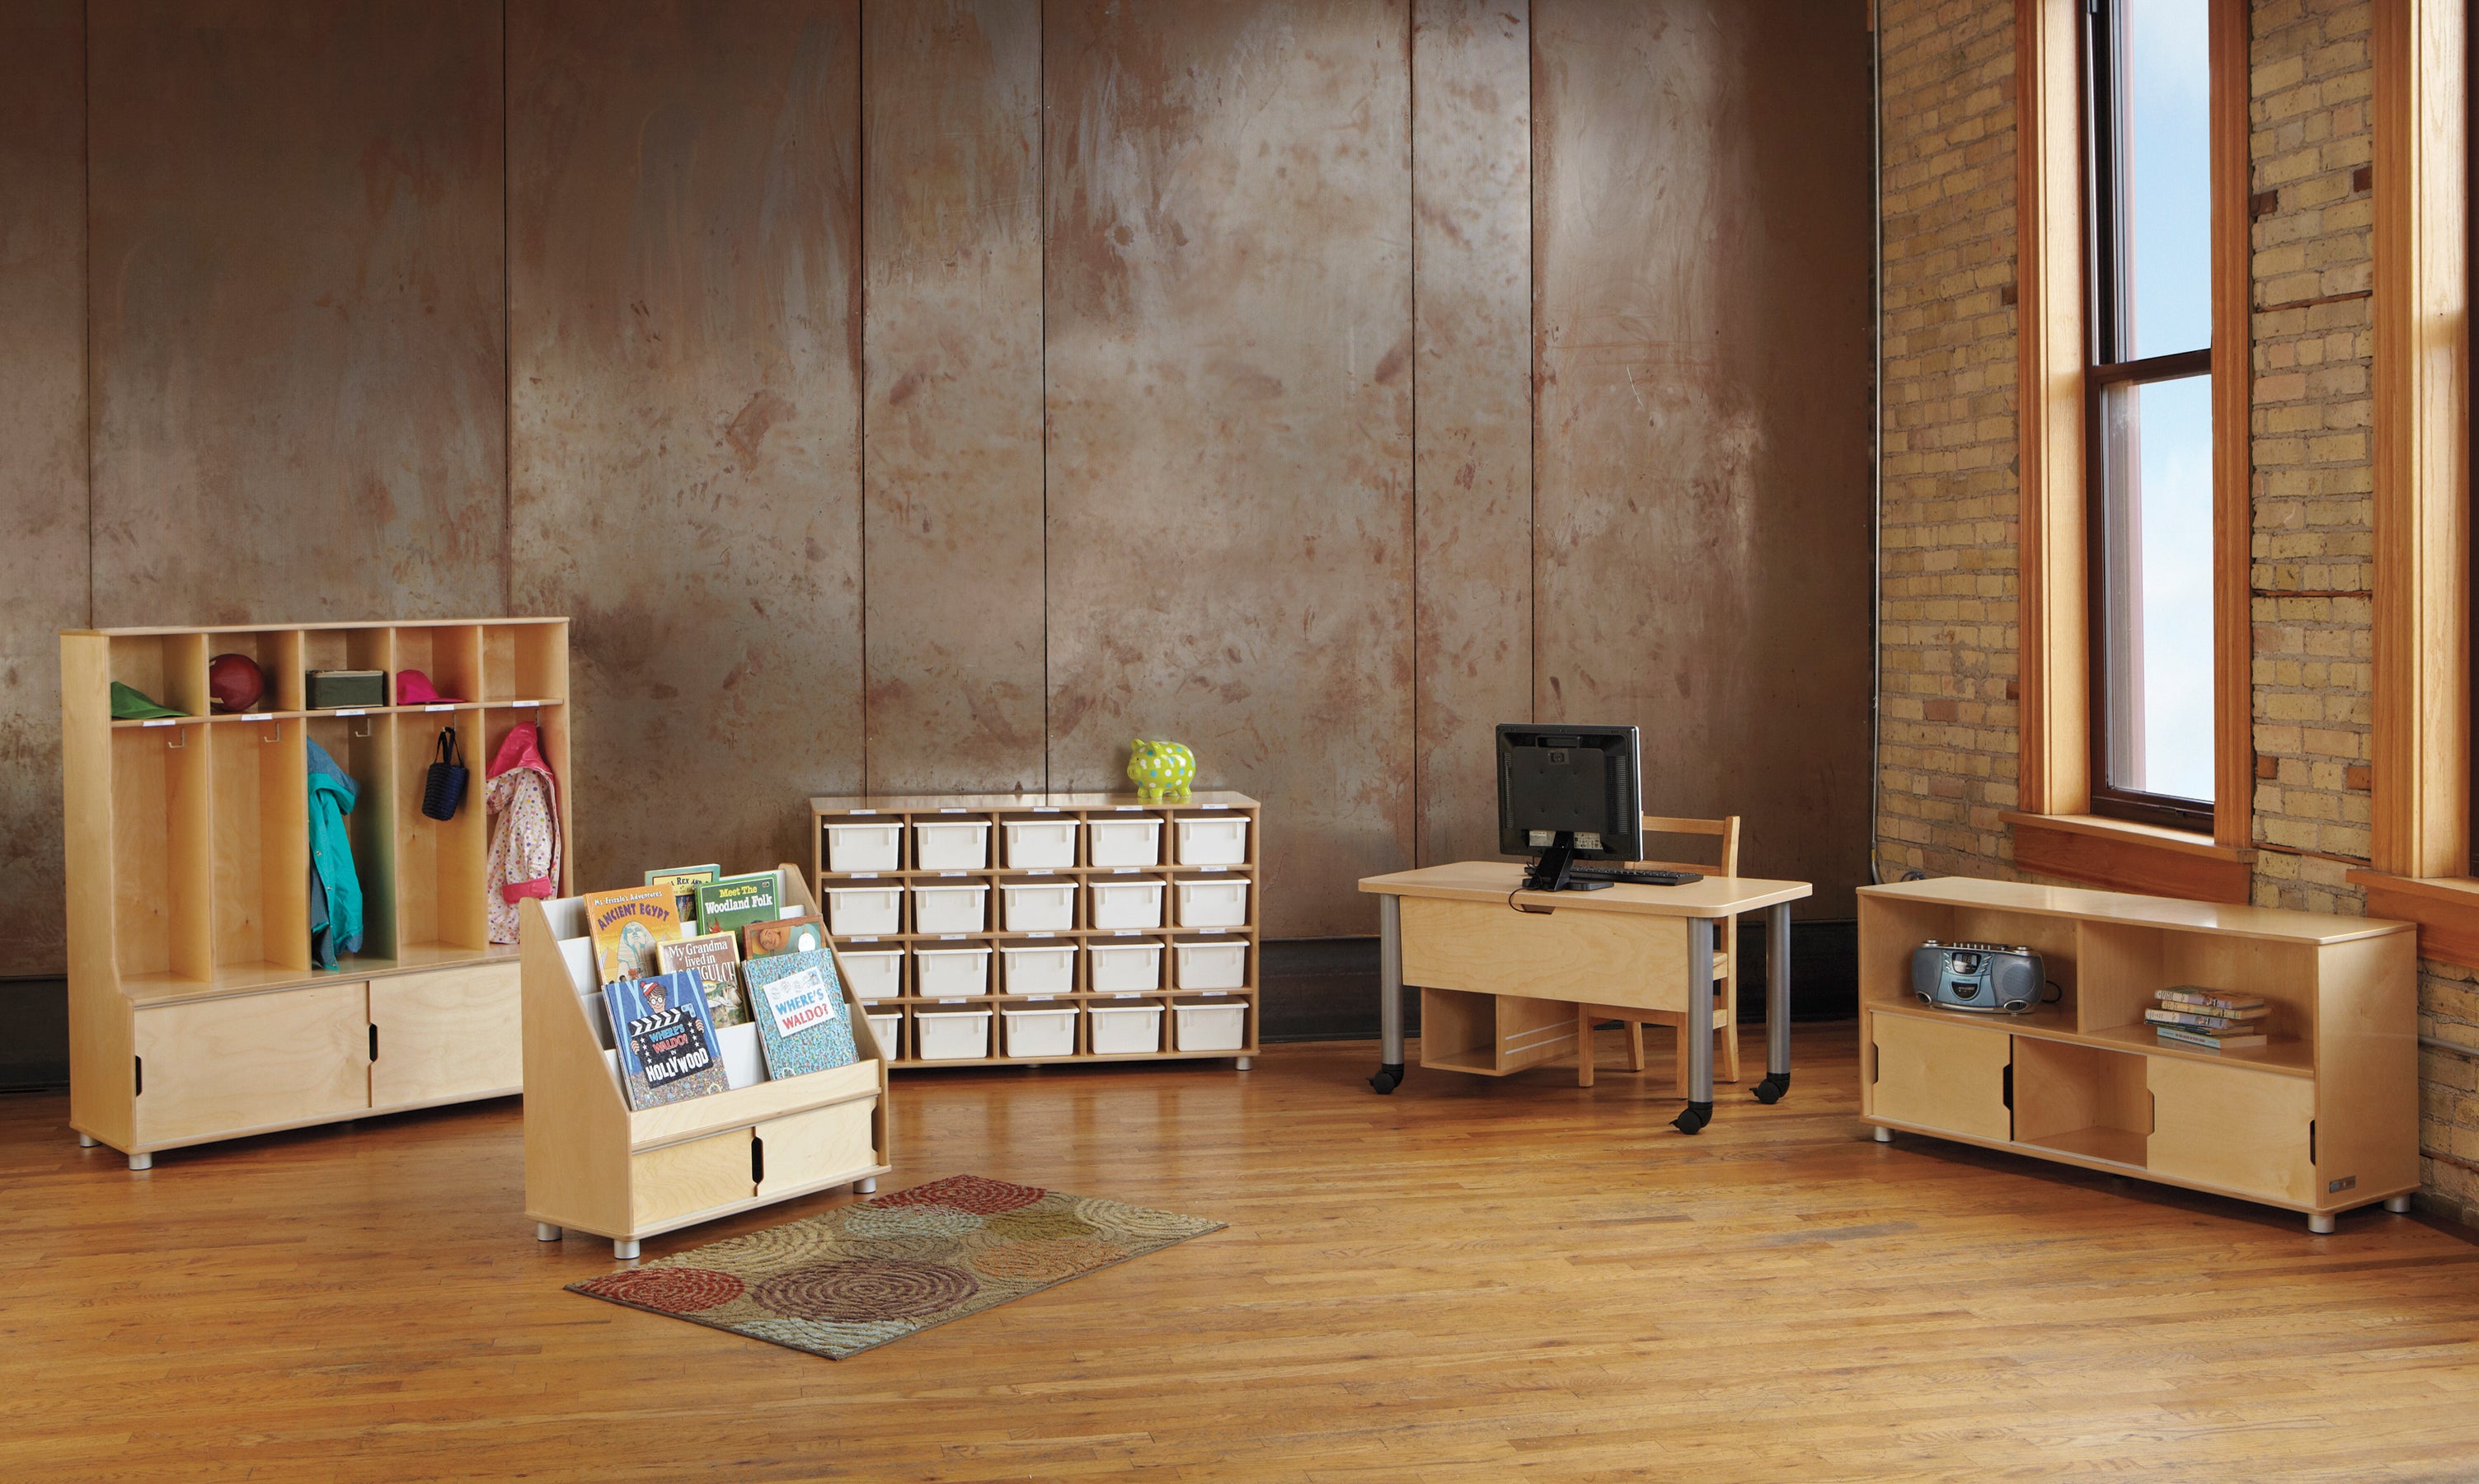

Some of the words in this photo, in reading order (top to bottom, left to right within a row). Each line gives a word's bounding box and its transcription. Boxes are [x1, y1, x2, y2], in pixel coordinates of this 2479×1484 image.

[630, 891, 663, 901] Adventures
[719, 886, 740, 898] Meet
[741, 885, 758, 894] The
[705, 897, 750, 914] Woodland
[751, 894, 772, 907] Folk
[597, 903, 636, 931] ANCIENT
[640, 903, 670, 922] EGYPT
[668, 945, 685, 960] My
[686, 940, 728, 956] Grandma
[685, 953, 706, 967] lived
[707, 953, 716, 964] in
[775, 988, 824, 1015] WHERE'S
[782, 1003, 829, 1030] WALDO?
[649, 1024, 685, 1043] WHERE'S
[646, 1048, 709, 1082] HOLLYWOOD
